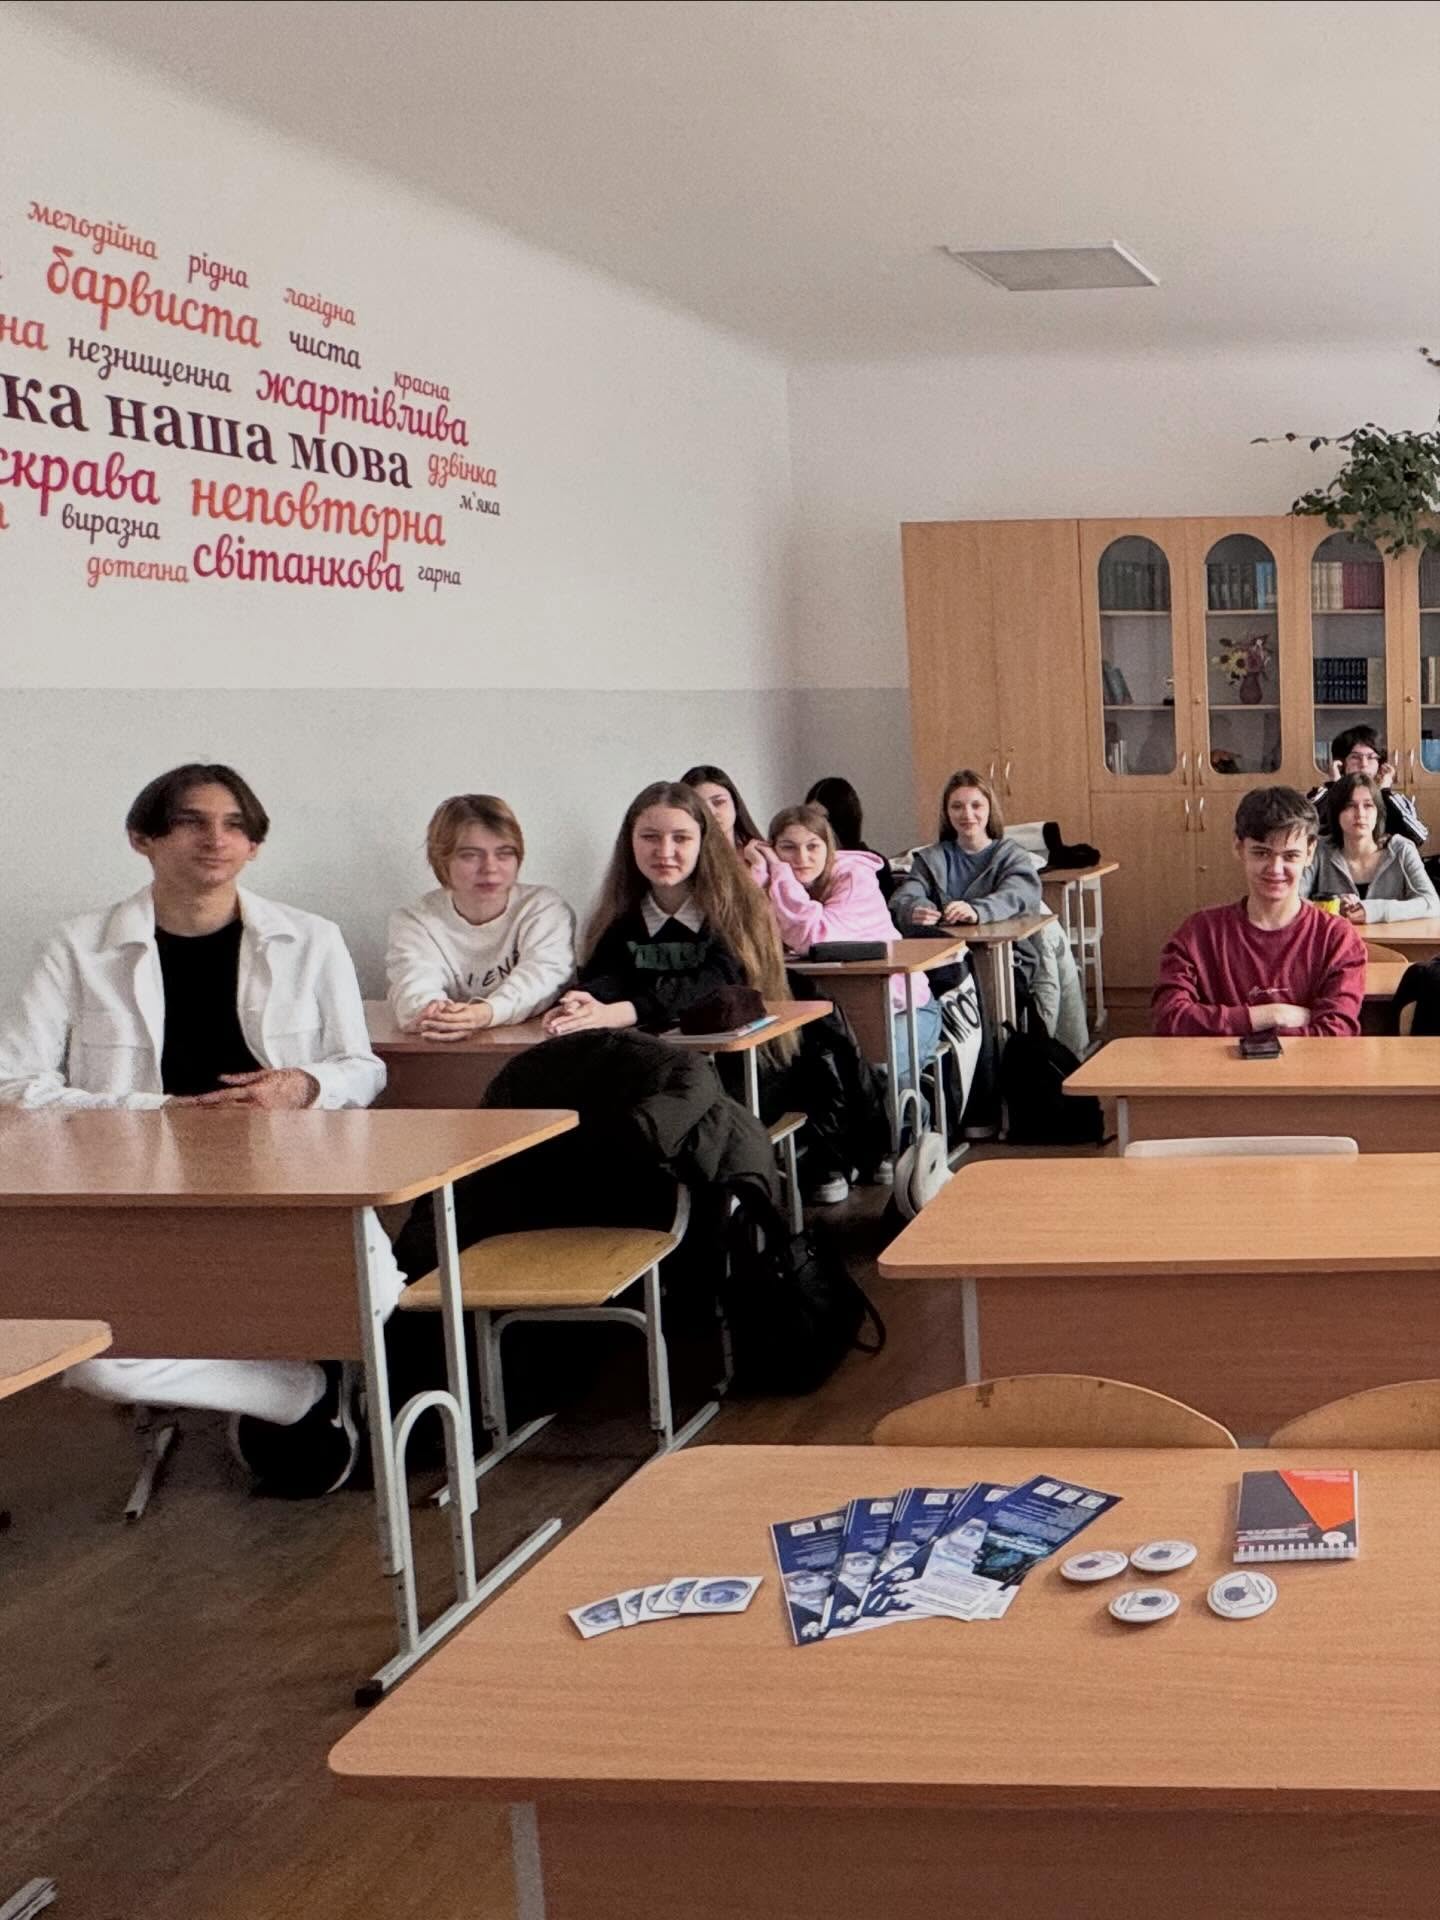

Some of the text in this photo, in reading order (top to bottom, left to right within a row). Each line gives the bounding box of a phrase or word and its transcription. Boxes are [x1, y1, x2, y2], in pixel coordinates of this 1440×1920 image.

[27, 201, 158, 260] мелодійна
[188, 252, 249, 291] рідна
[47, 245, 262, 348] барвиста
[283, 287, 356, 328] лагідна
[68, 336, 232, 393] незнищенна
[289, 330, 361, 369] чиста
[256, 369, 469, 447] жартівлива
[394, 371, 451, 401] красна
[0, 373, 413, 488] ка наша мова
[428, 452, 497, 488] дзвінка
[62, 503, 160, 548] виразна
[191, 481, 446, 562] неповторна
[87, 556, 189, 588] дотепна
[193, 534, 404, 592] світанкова
[418, 566, 462, 592] гарна
